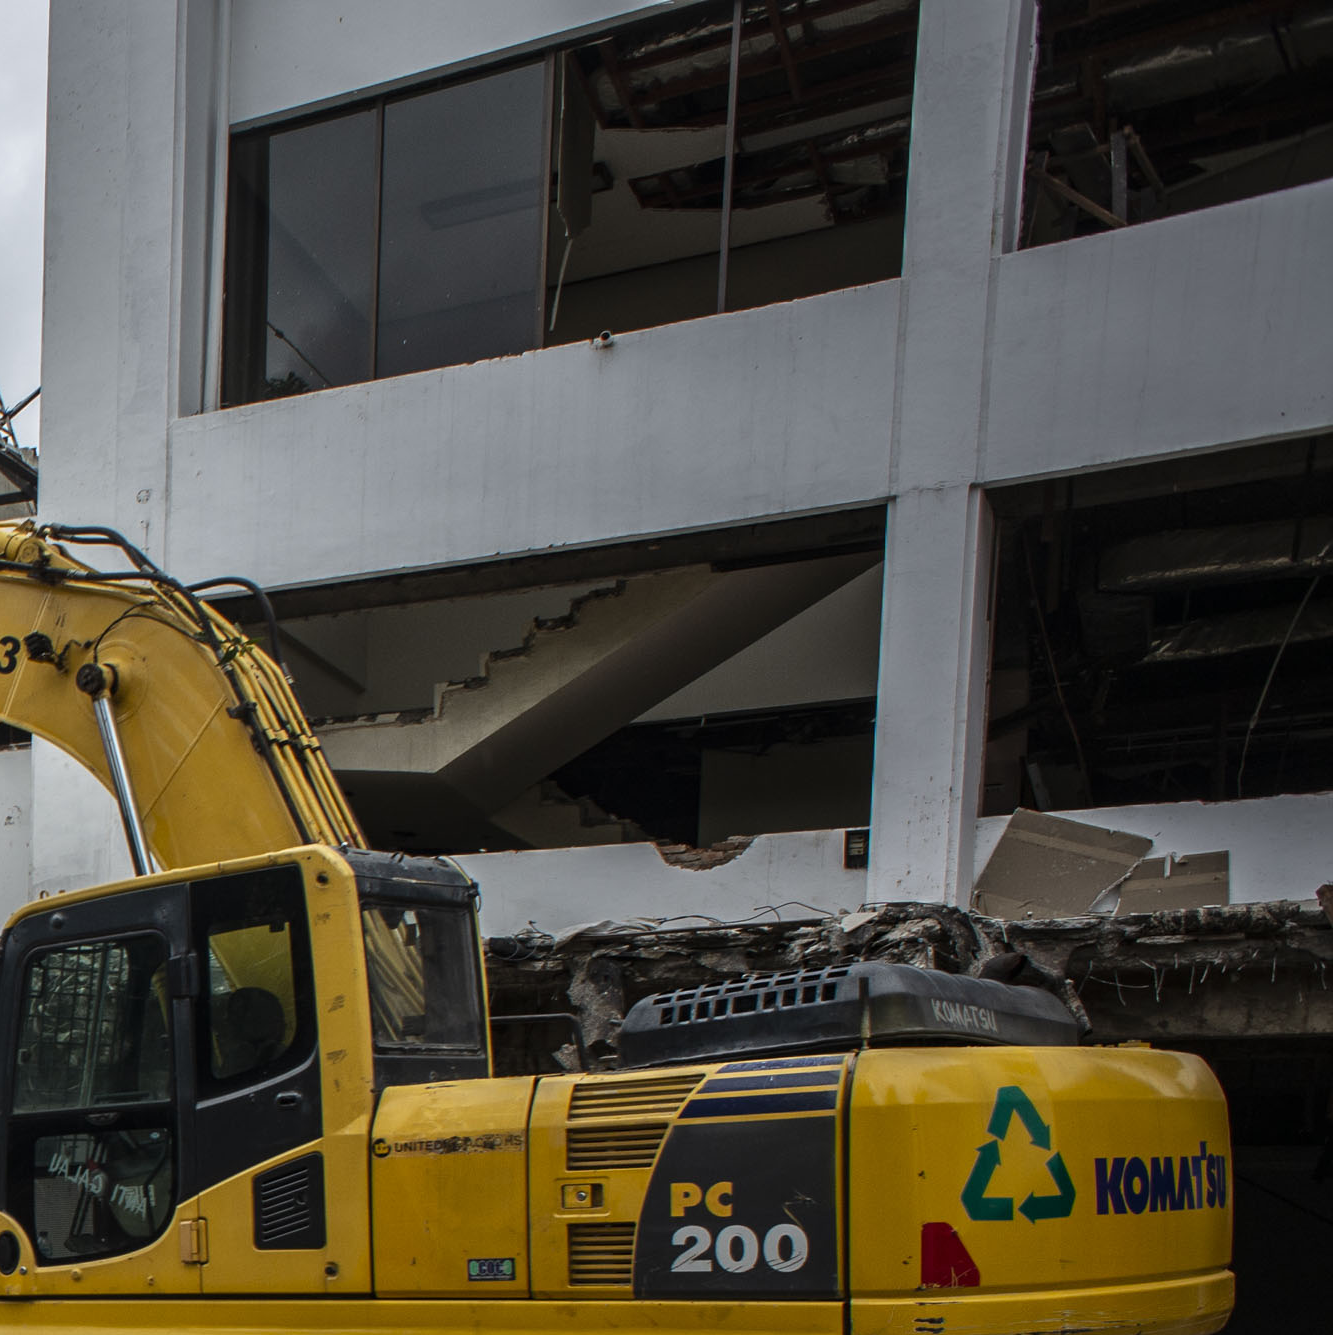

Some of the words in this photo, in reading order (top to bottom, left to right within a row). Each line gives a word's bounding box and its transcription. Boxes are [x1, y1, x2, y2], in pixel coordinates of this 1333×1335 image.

[931, 998, 998, 1033] KOMATSU
[394, 1139, 443, 1153] UNITED
[1094, 1140, 1226, 1215] KOMATSU
[670, 1181, 733, 1217] PC
[670, 1223, 810, 1273] 200
